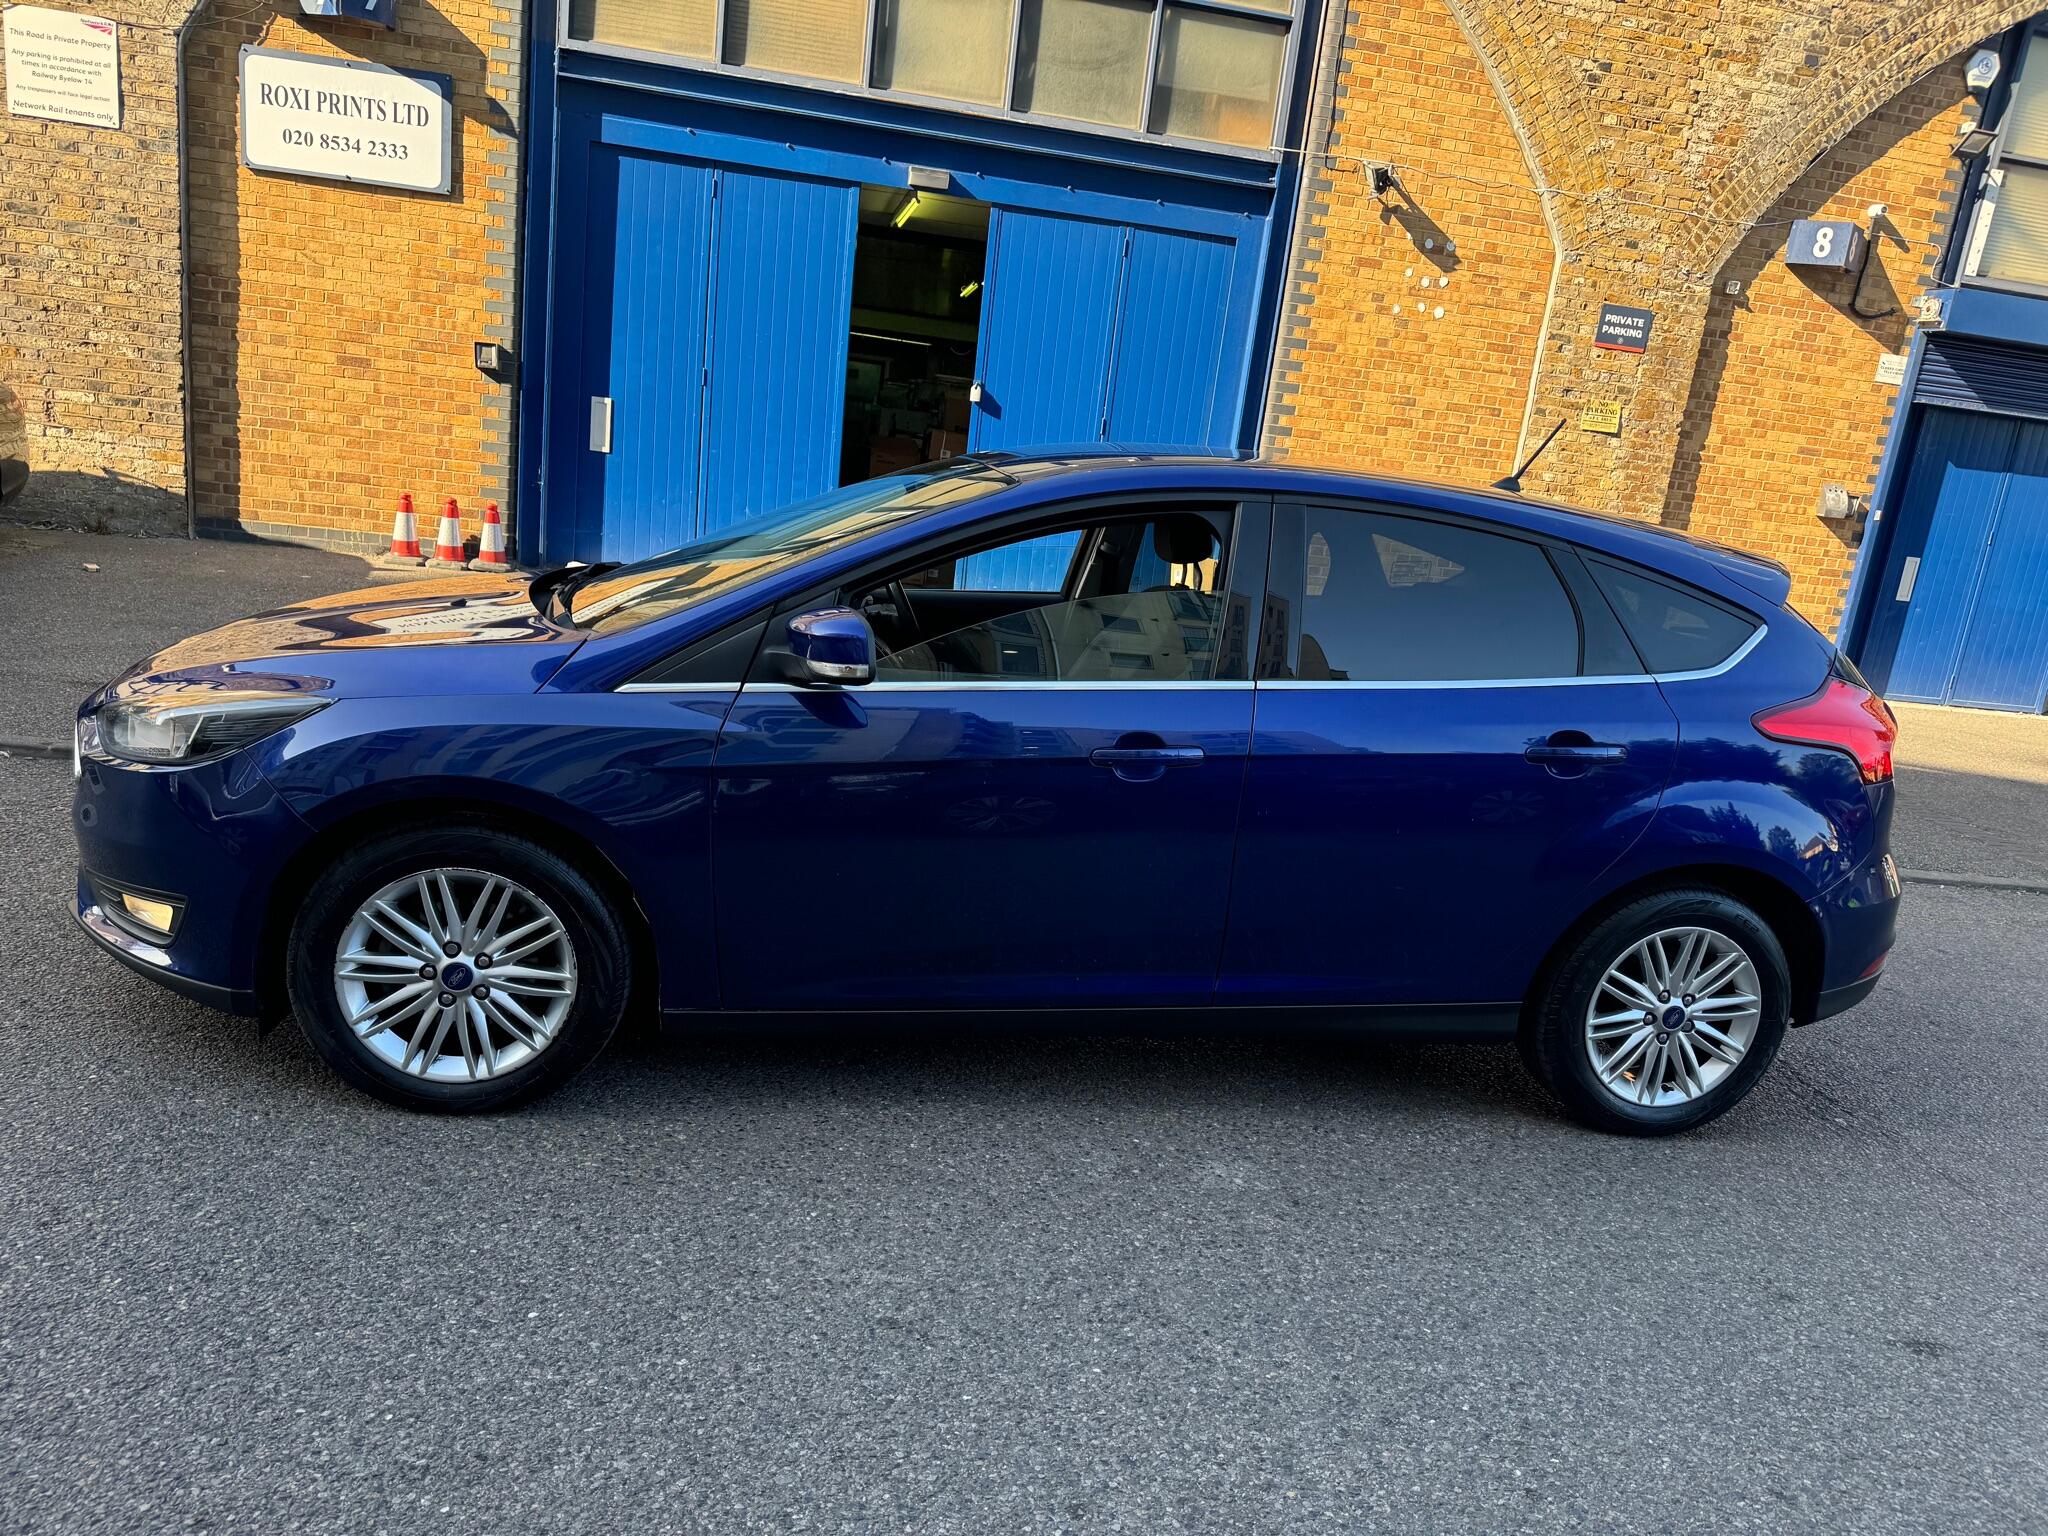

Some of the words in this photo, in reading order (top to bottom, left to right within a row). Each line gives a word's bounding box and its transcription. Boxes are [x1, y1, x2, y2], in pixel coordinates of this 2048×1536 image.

[9, 27, 25, 36] This
[26, 30, 45, 40] Road
[54, 35, 79, 45] Private
[80, 39, 112, 51] Property
[11, 48, 25, 56] Any
[26, 51, 51, 61] parking
[59, 56, 93, 66] prohibited
[21, 60, 40, 68] times
[49, 65, 86, 75] accordance
[87, 69, 102, 77] with
[32, 71, 58, 81] Railway
[59, 75, 82, 84] Byelaw
[80, 93, 92, 101] legal
[260, 83, 310, 111] ROXI
[317, 91, 387, 122] PRINTS
[392, 101, 429, 127] LTD
[13, 100, 46, 111] Network
[48, 104, 63, 114] Rail
[65, 107, 95, 119] tenants
[97, 113, 113, 122] only
[282, 128, 314, 147] 020
[320, 133, 361, 154] 8534
[367, 140, 409, 160] 2333
[1812, 226, 1834, 258] 8
[1848, 231, 1859, 263] 8
[1605, 314, 1645, 327] PRIVATE
[1601, 325, 1643, 339] PARKING
[1586, 406, 1618, 416] PARKING
